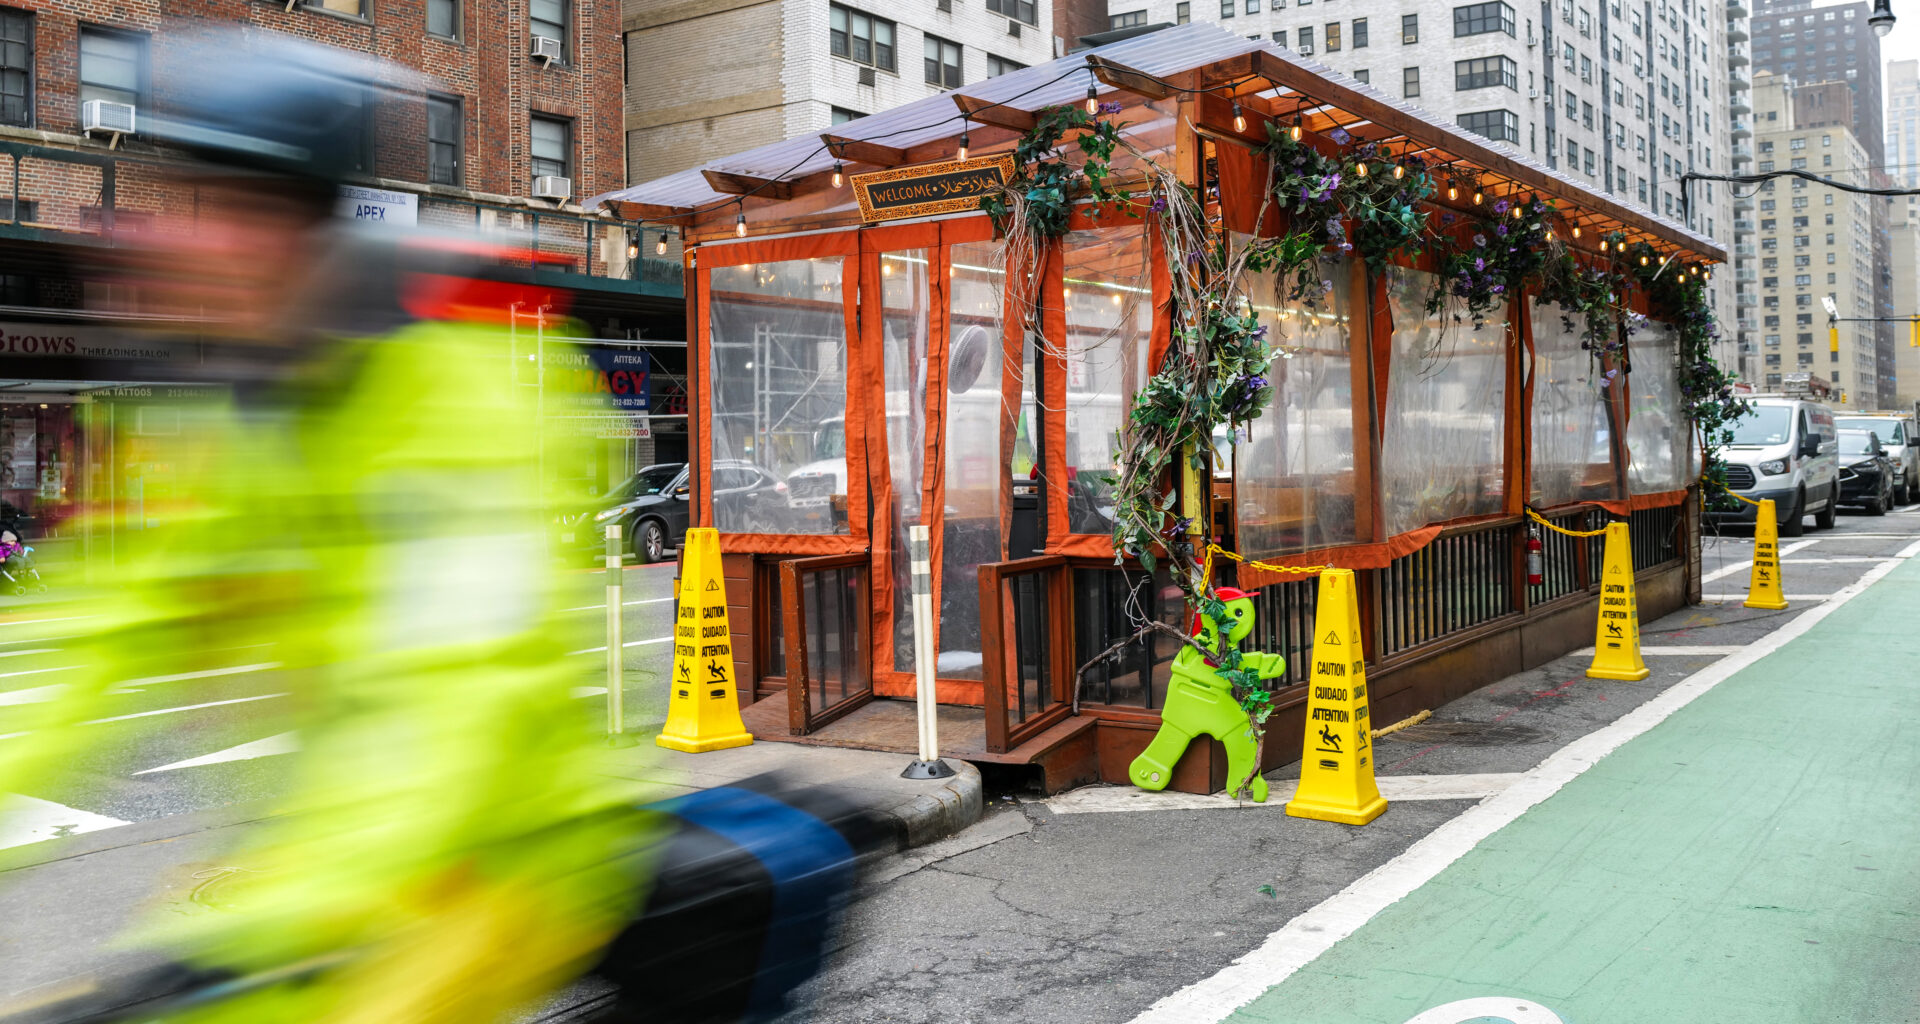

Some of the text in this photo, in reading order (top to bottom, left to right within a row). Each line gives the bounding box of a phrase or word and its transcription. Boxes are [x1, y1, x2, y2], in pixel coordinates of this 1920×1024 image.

[873, 183, 933, 204] WELCOME
[355, 204, 386, 221] APEX
[81, 346, 170, 359] THREADING SALON
[114, 387, 152, 398] TATTOOS
[612, 398, 646, 406] 212-832-7200
[605, 428, 649, 437] 212-832-7200
[1605, 584, 1625, 593] CAUTION
[1603, 597, 1626, 606] CUIDADO
[680, 606, 695, 619] CAUTION
[702, 605, 725, 619] CAUTION
[1602, 610, 1627, 619] ATTENTION
[702, 625, 727, 639] CUIDADO
[676, 644, 696, 657] ATTENTION
[701, 644, 730, 657] ATTENTION
[1317, 661, 1346, 677] CAUTION
[1315, 686, 1347, 701] CUIDADO
[1312, 707, 1349, 723] ATTENTION
